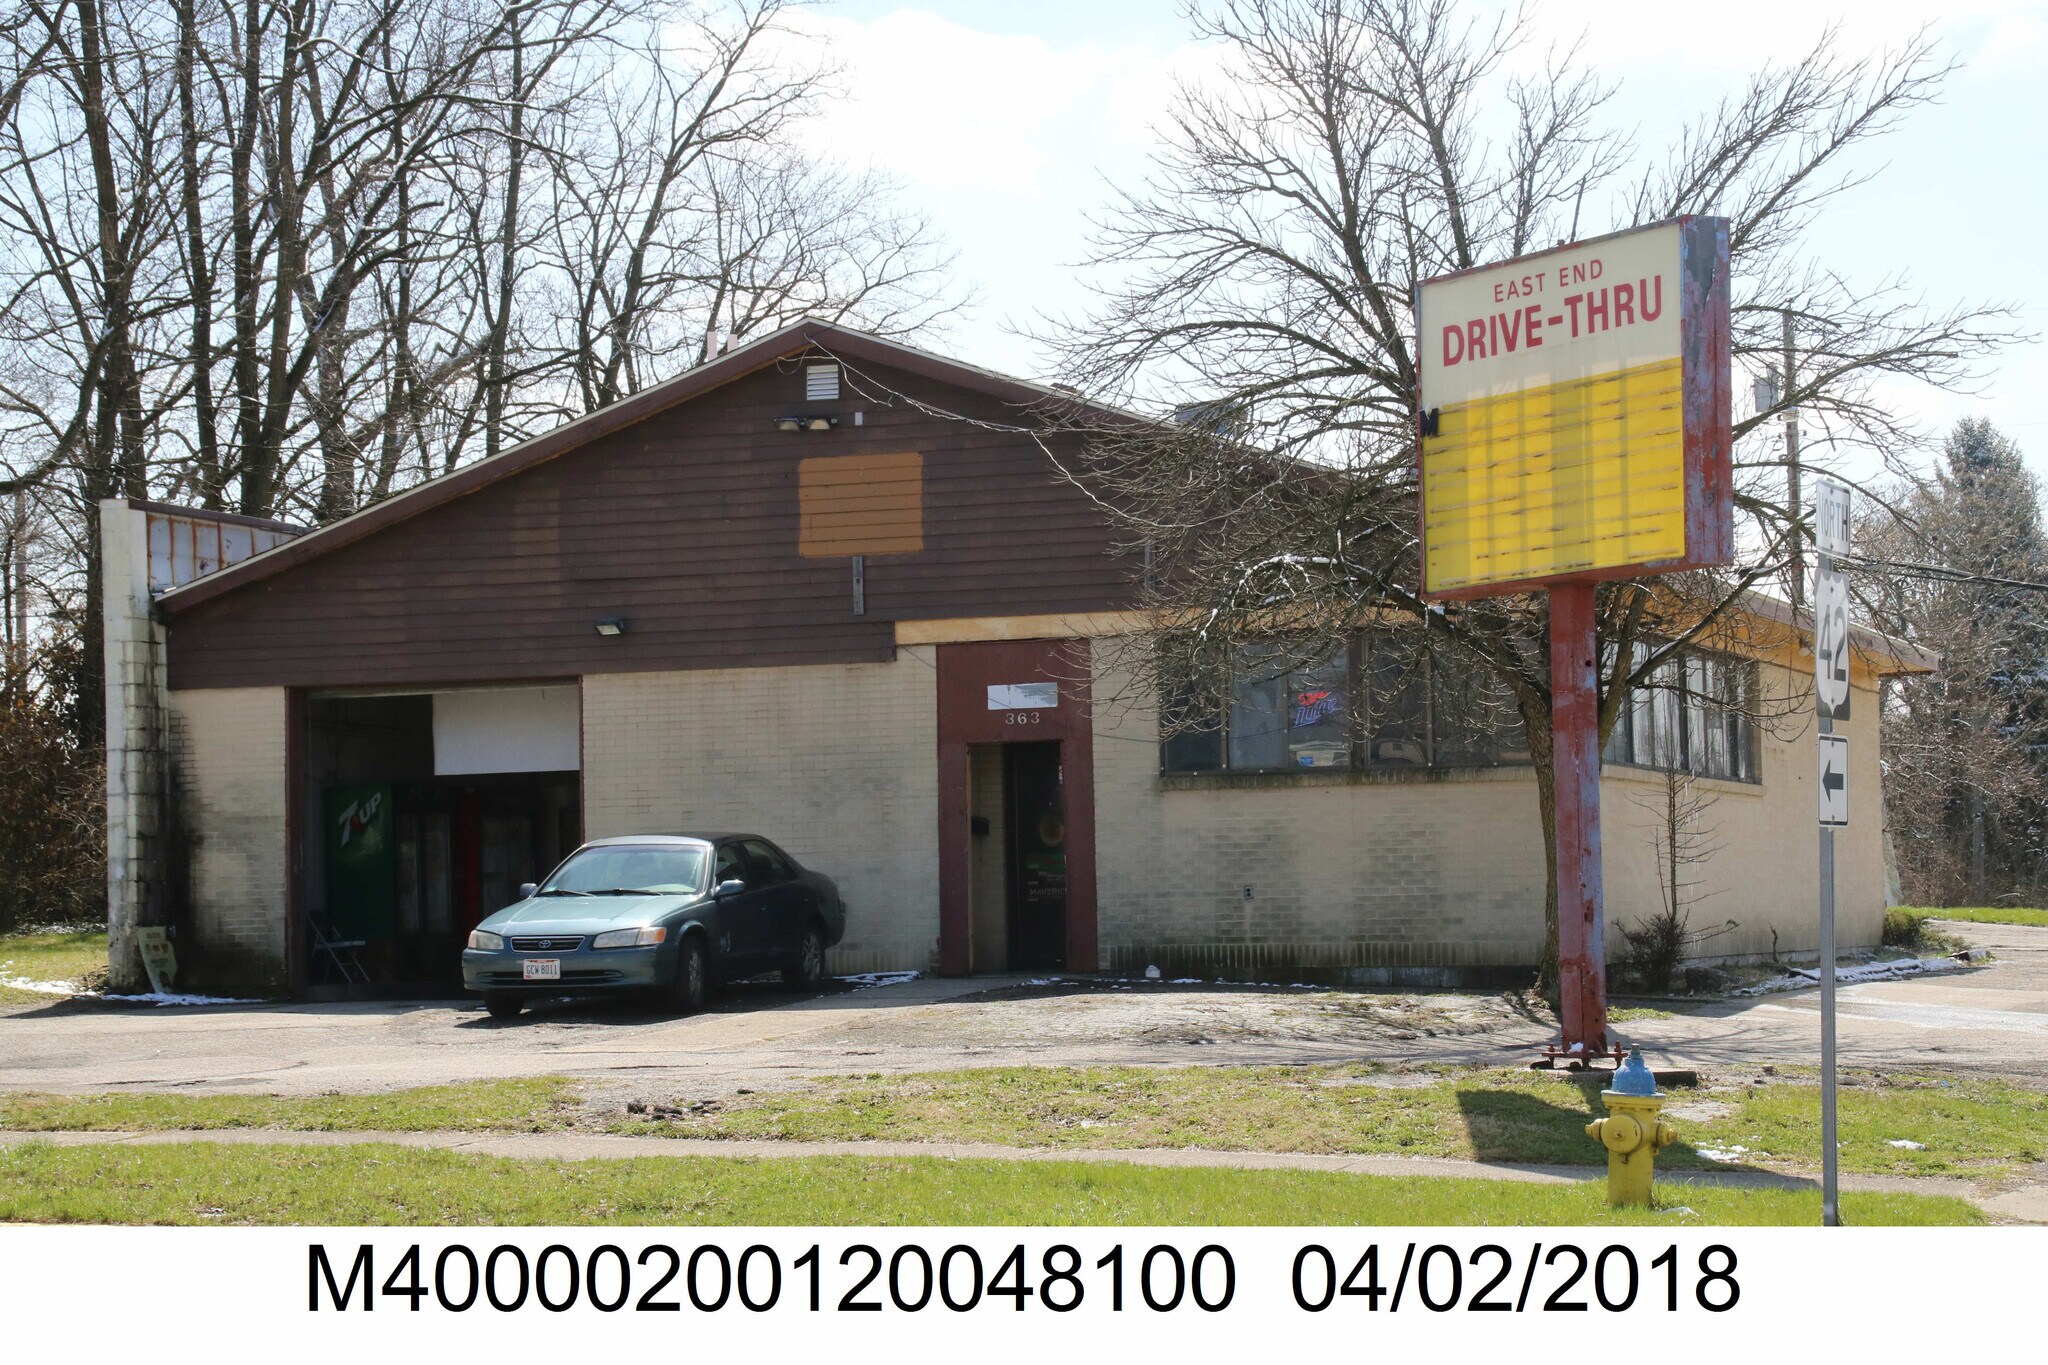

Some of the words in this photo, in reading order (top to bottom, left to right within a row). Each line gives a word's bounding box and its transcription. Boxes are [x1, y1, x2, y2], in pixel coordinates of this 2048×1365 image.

[1494, 272, 1546, 303] EAST
[1559, 258, 1604, 288] END
[1443, 274, 1662, 367] DRIVE-THRU
[1817, 492, 1849, 542] NORTH
[1818, 604, 1847, 683] 42
[1005, 711, 1040, 725] 363
[338, 792, 382, 848] 7UP
[1029, 887, 1067, 897] MAVERIC
